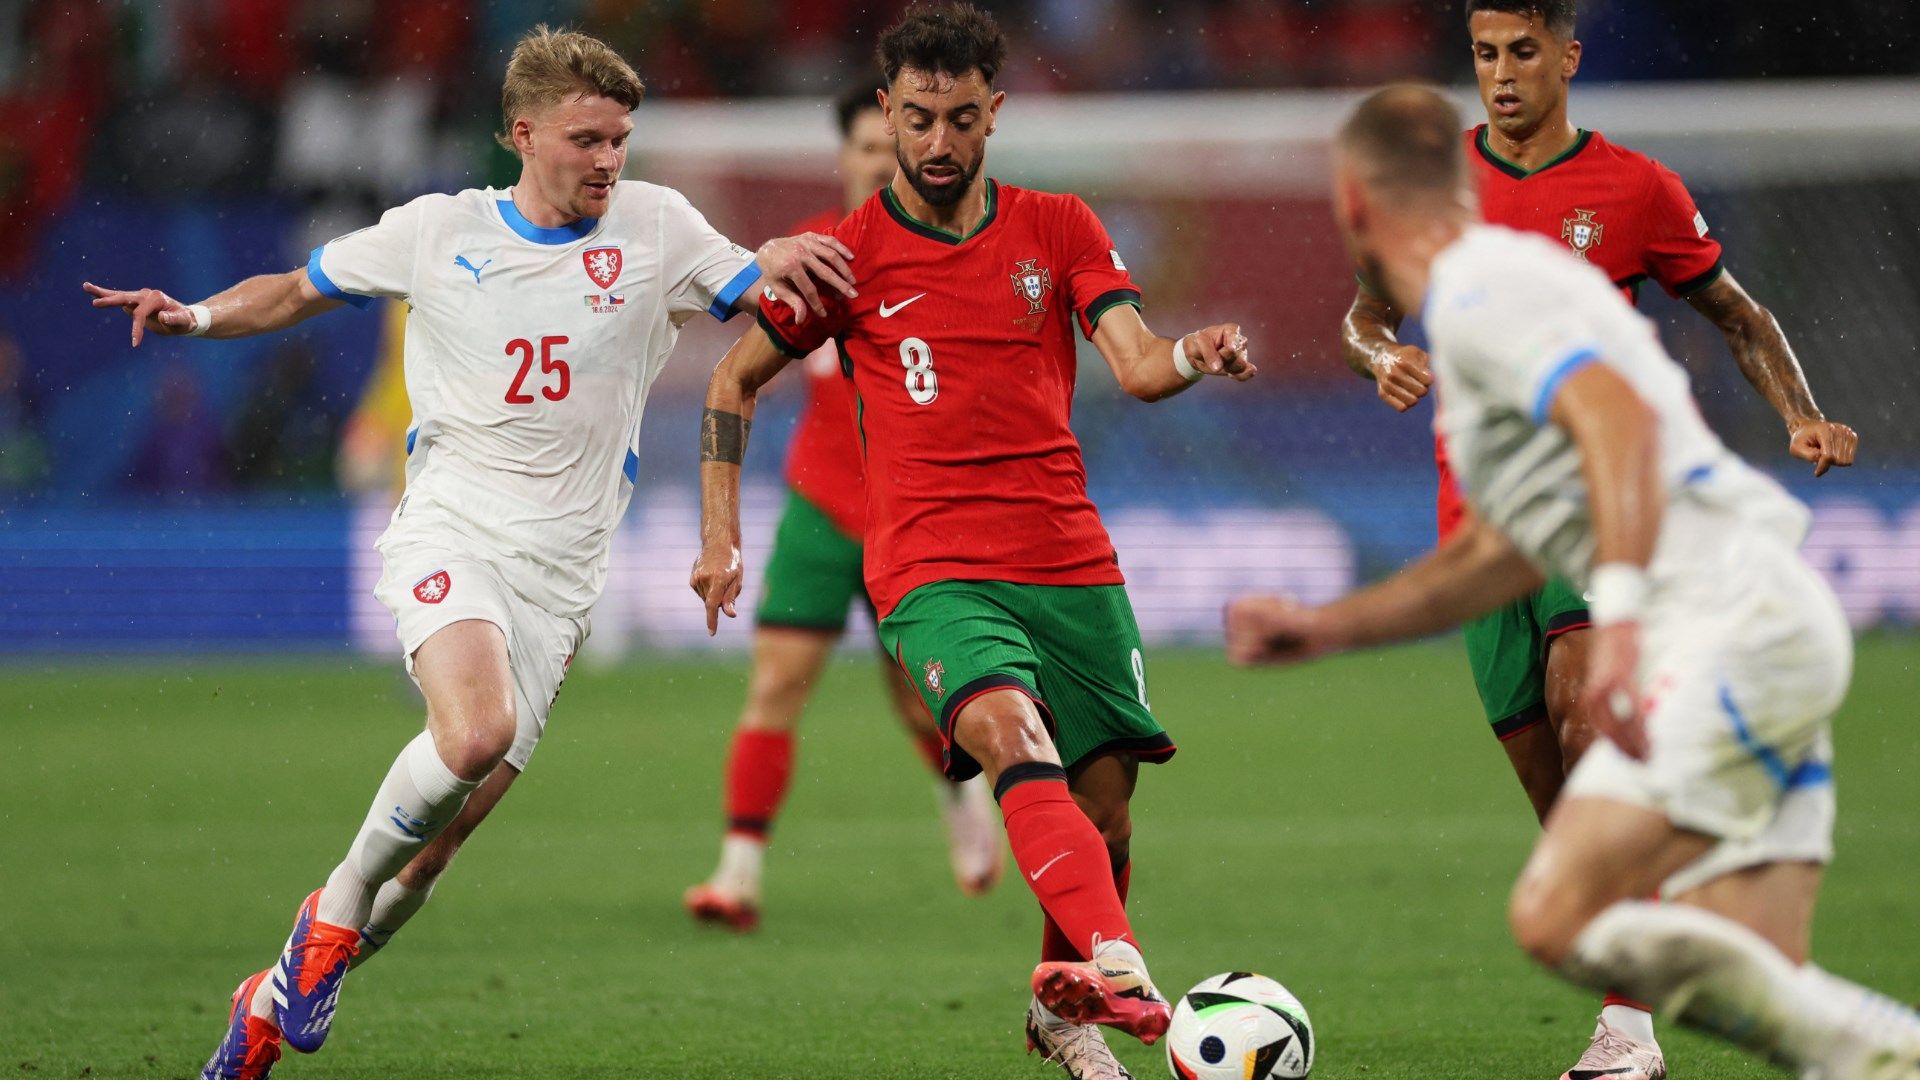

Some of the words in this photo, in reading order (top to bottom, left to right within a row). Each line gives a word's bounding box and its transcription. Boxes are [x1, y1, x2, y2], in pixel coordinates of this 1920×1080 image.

[592, 305, 619, 314] 18.6.2024
[504, 335, 571, 404] 25
[899, 337, 939, 405] 8
[1131, 647, 1151, 713] 8
